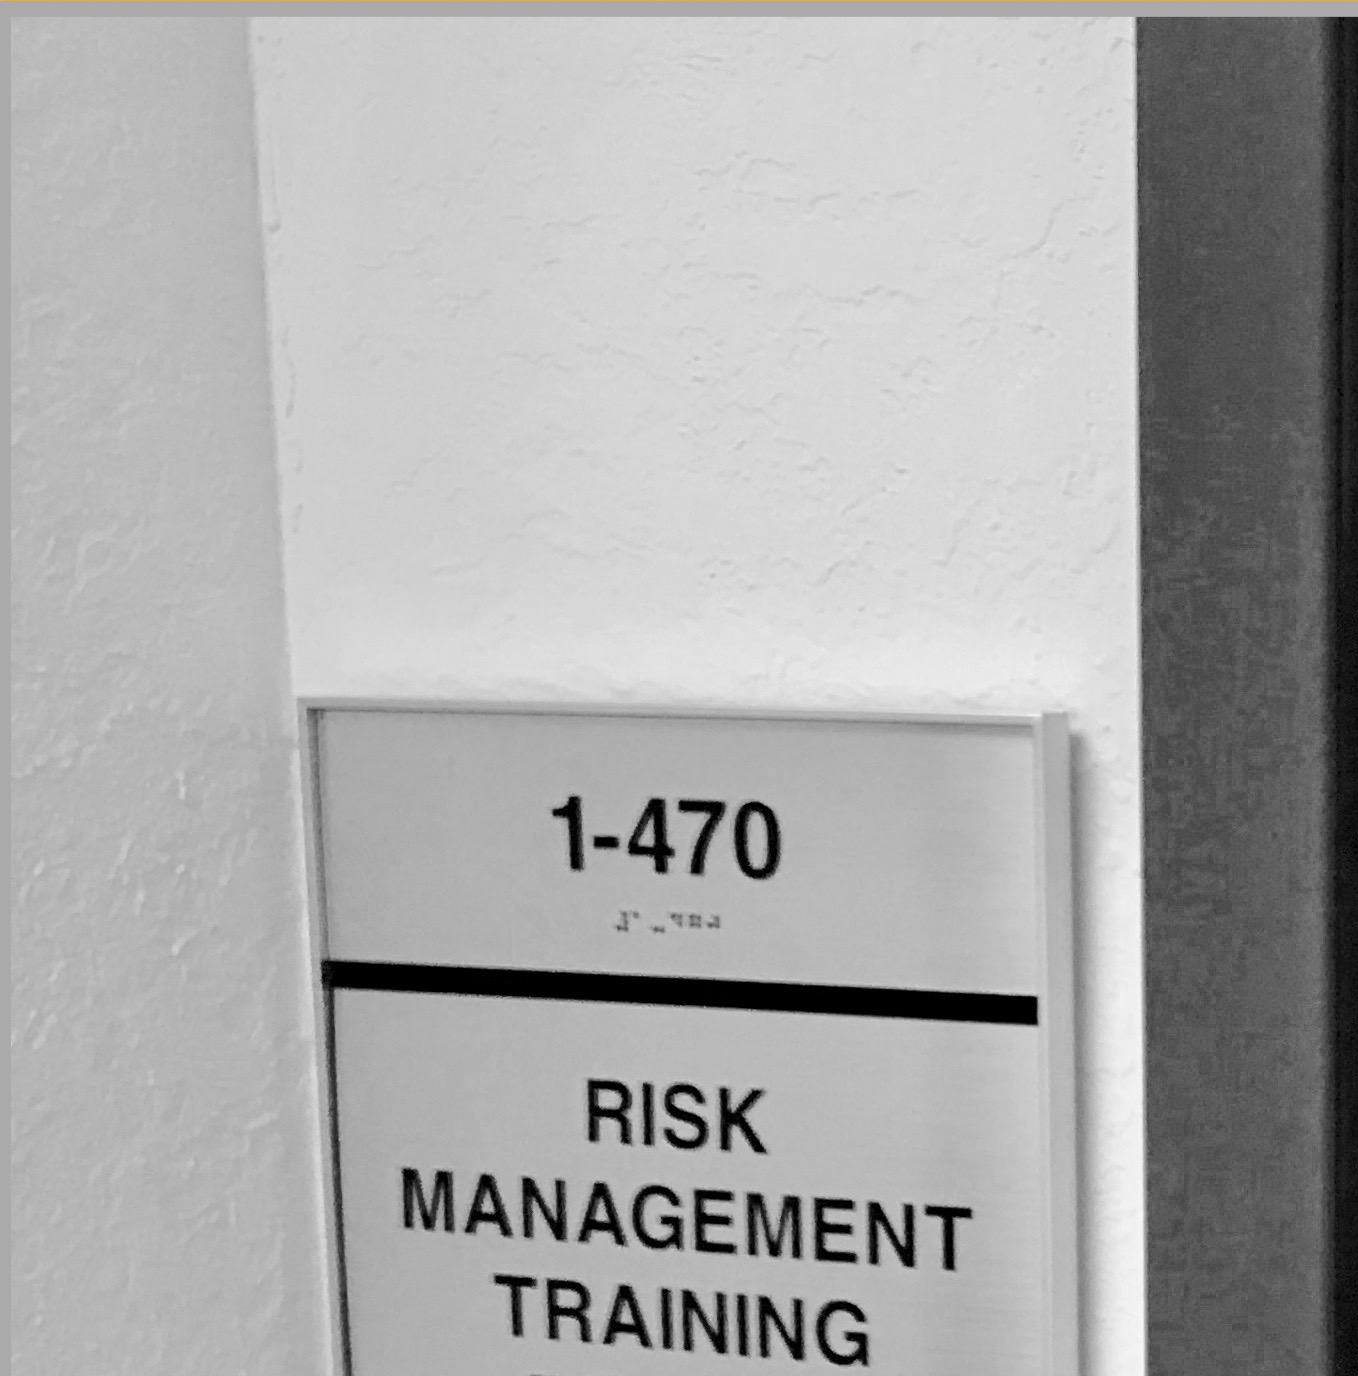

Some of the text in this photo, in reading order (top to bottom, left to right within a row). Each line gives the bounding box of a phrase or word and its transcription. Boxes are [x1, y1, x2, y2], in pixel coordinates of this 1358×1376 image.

[550, 795, 782, 881] 1-470
[586, 1078, 768, 1156] RISK
[401, 1167, 973, 1272] MANAGEMENT
[493, 1273, 870, 1367] TRAINING
